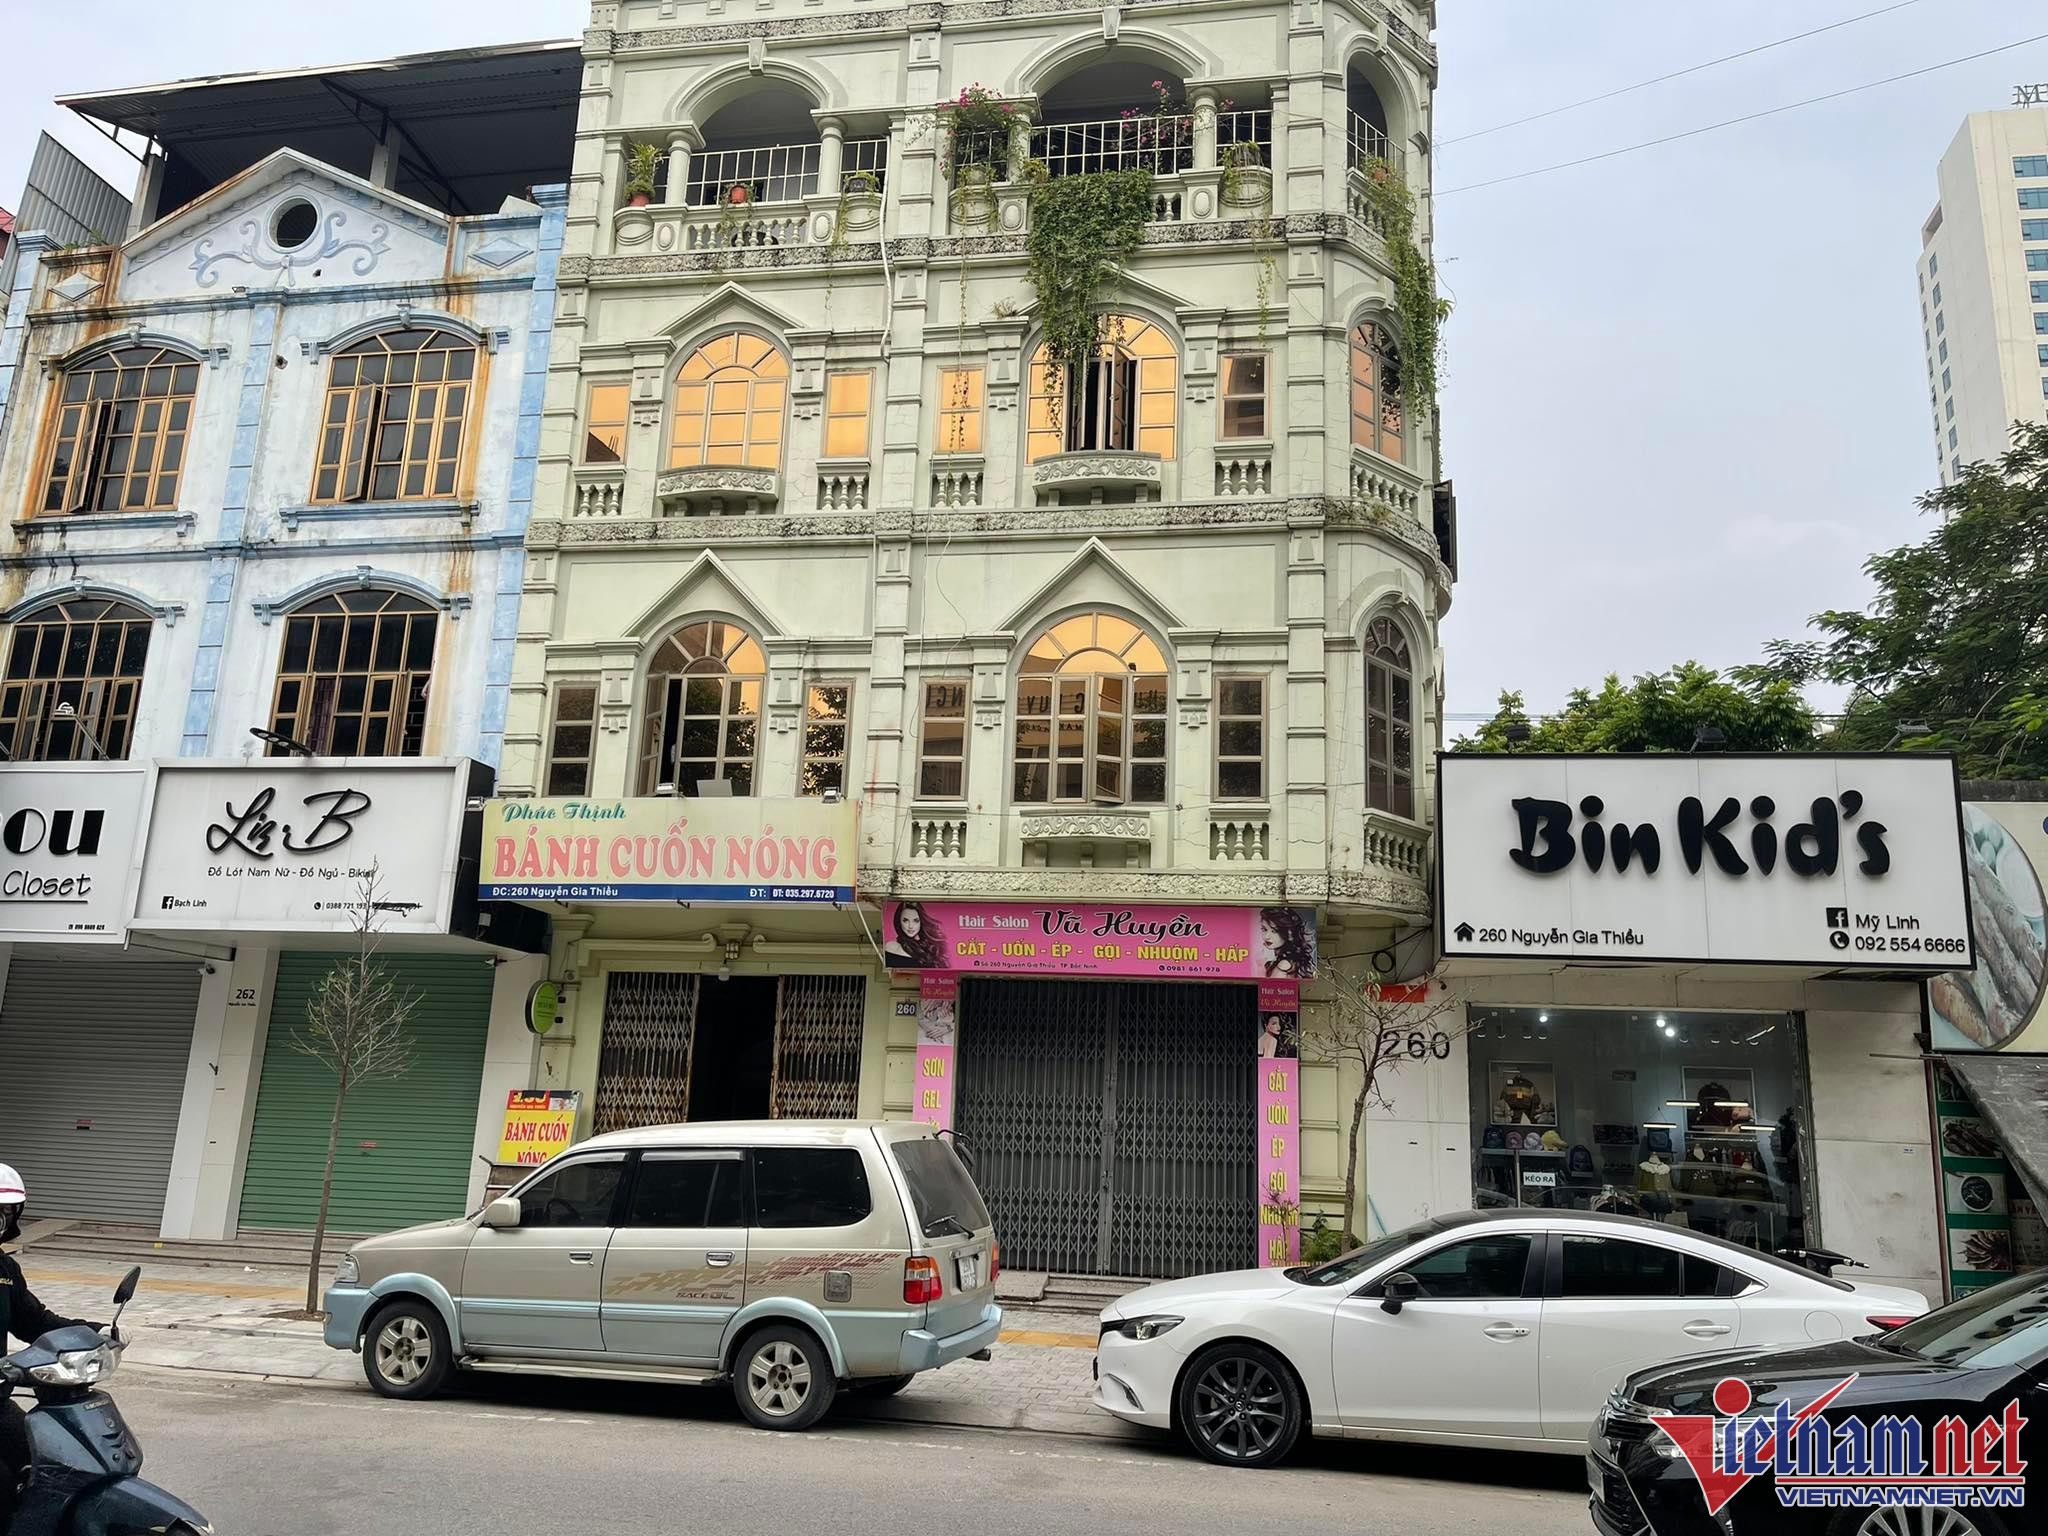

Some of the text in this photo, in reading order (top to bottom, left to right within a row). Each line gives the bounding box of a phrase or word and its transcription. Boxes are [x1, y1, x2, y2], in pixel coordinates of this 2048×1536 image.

[563, 802, 626, 822] Thịnh
[0, 808, 105, 856] ou
[1508, 789, 1891, 877] Bin Kid's
[494, 817, 838, 880] BÁNH CUỐN NÓNG
[3, 870, 91, 896] Closet
[226, 866, 243, 877] Lót
[247, 867, 271, 877] Nam
[275, 867, 290, 878] Nữ
[318, 867, 338, 880] Ngủ
[530, 886, 569, 899] Nguyễn
[570, 887, 588, 896] Gia
[589, 886, 618, 896] Thiều
[749, 888, 767, 898] ĐT:
[958, 915, 1029, 928] Hair Salon
[1092, 911, 1208, 944] Huyền
[1855, 913, 1920, 933] Mỹ Linh
[1479, 929, 1507, 943] 260
[1511, 927, 1569, 946] Nguyễn
[1572, 930, 1599, 944] Gia
[1855, 936, 1966, 953] 092 554 6666
[956, 938, 986, 956] CẮT
[1002, 939, 1036, 957] UỐN
[1051, 941, 1072, 958] ÉP
[1093, 943, 1121, 961] GỘI
[1137, 944, 1198, 963] NHUỘM
[1215, 944, 1249, 963] HẤP
[236, 989, 255, 999] 262
[897, 1003, 915, 1015] 260
[1383, 1031, 1450, 1059] 260
[1268, 1065, 1287, 1092] CẮT
[504, 1114, 570, 1142] BÁNH CUỐN
[1271, 1134, 1285, 1158] ÉP
[1525, 1175, 1541, 1183] KÉO
